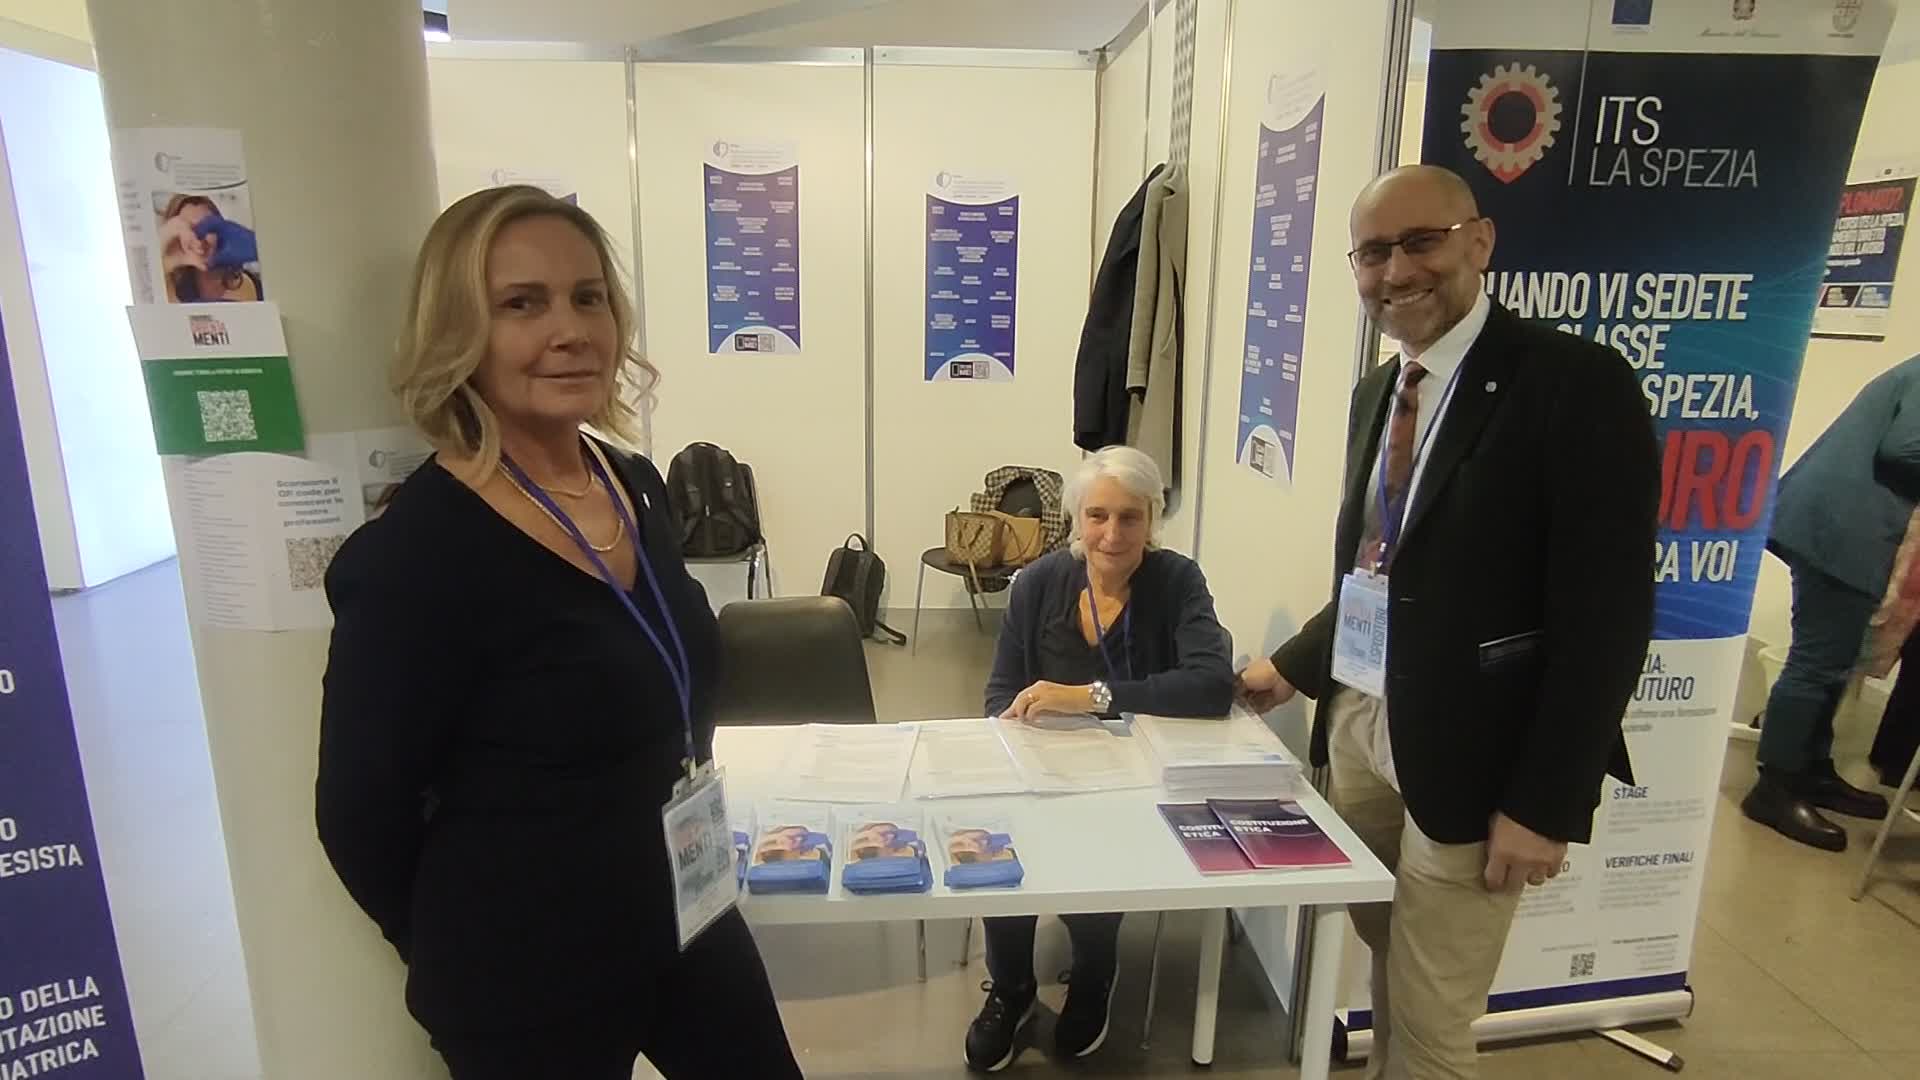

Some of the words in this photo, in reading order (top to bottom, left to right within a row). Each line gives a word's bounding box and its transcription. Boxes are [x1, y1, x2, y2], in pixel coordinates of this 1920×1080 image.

[1596, 96, 1663, 145] ITS
[1589, 147, 1631, 186] LA
[1639, 148, 1758, 187] SPEZIA
[1487, 271, 1591, 319] UANDO
[1600, 272, 1629, 319] VI
[1632, 272, 1754, 320] SEDETE
[192, 330, 230, 346] MENTI
[1642, 373, 1759, 421] SPEZIA,
[1691, 539, 1739, 582] VOI
[1633, 675, 1695, 701] UTURO
[1613, 786, 1648, 800] STAGE
[1178, 824, 1225, 832] COSTITU
[1229, 818, 1309, 827] COSTITUZIONE
[1234, 825, 1273, 833] ETICA
[1605, 854, 1660, 868] VERIFICHE
[1662, 851, 1695, 864] FINALI
[20, 975, 100, 1013] DELLA
